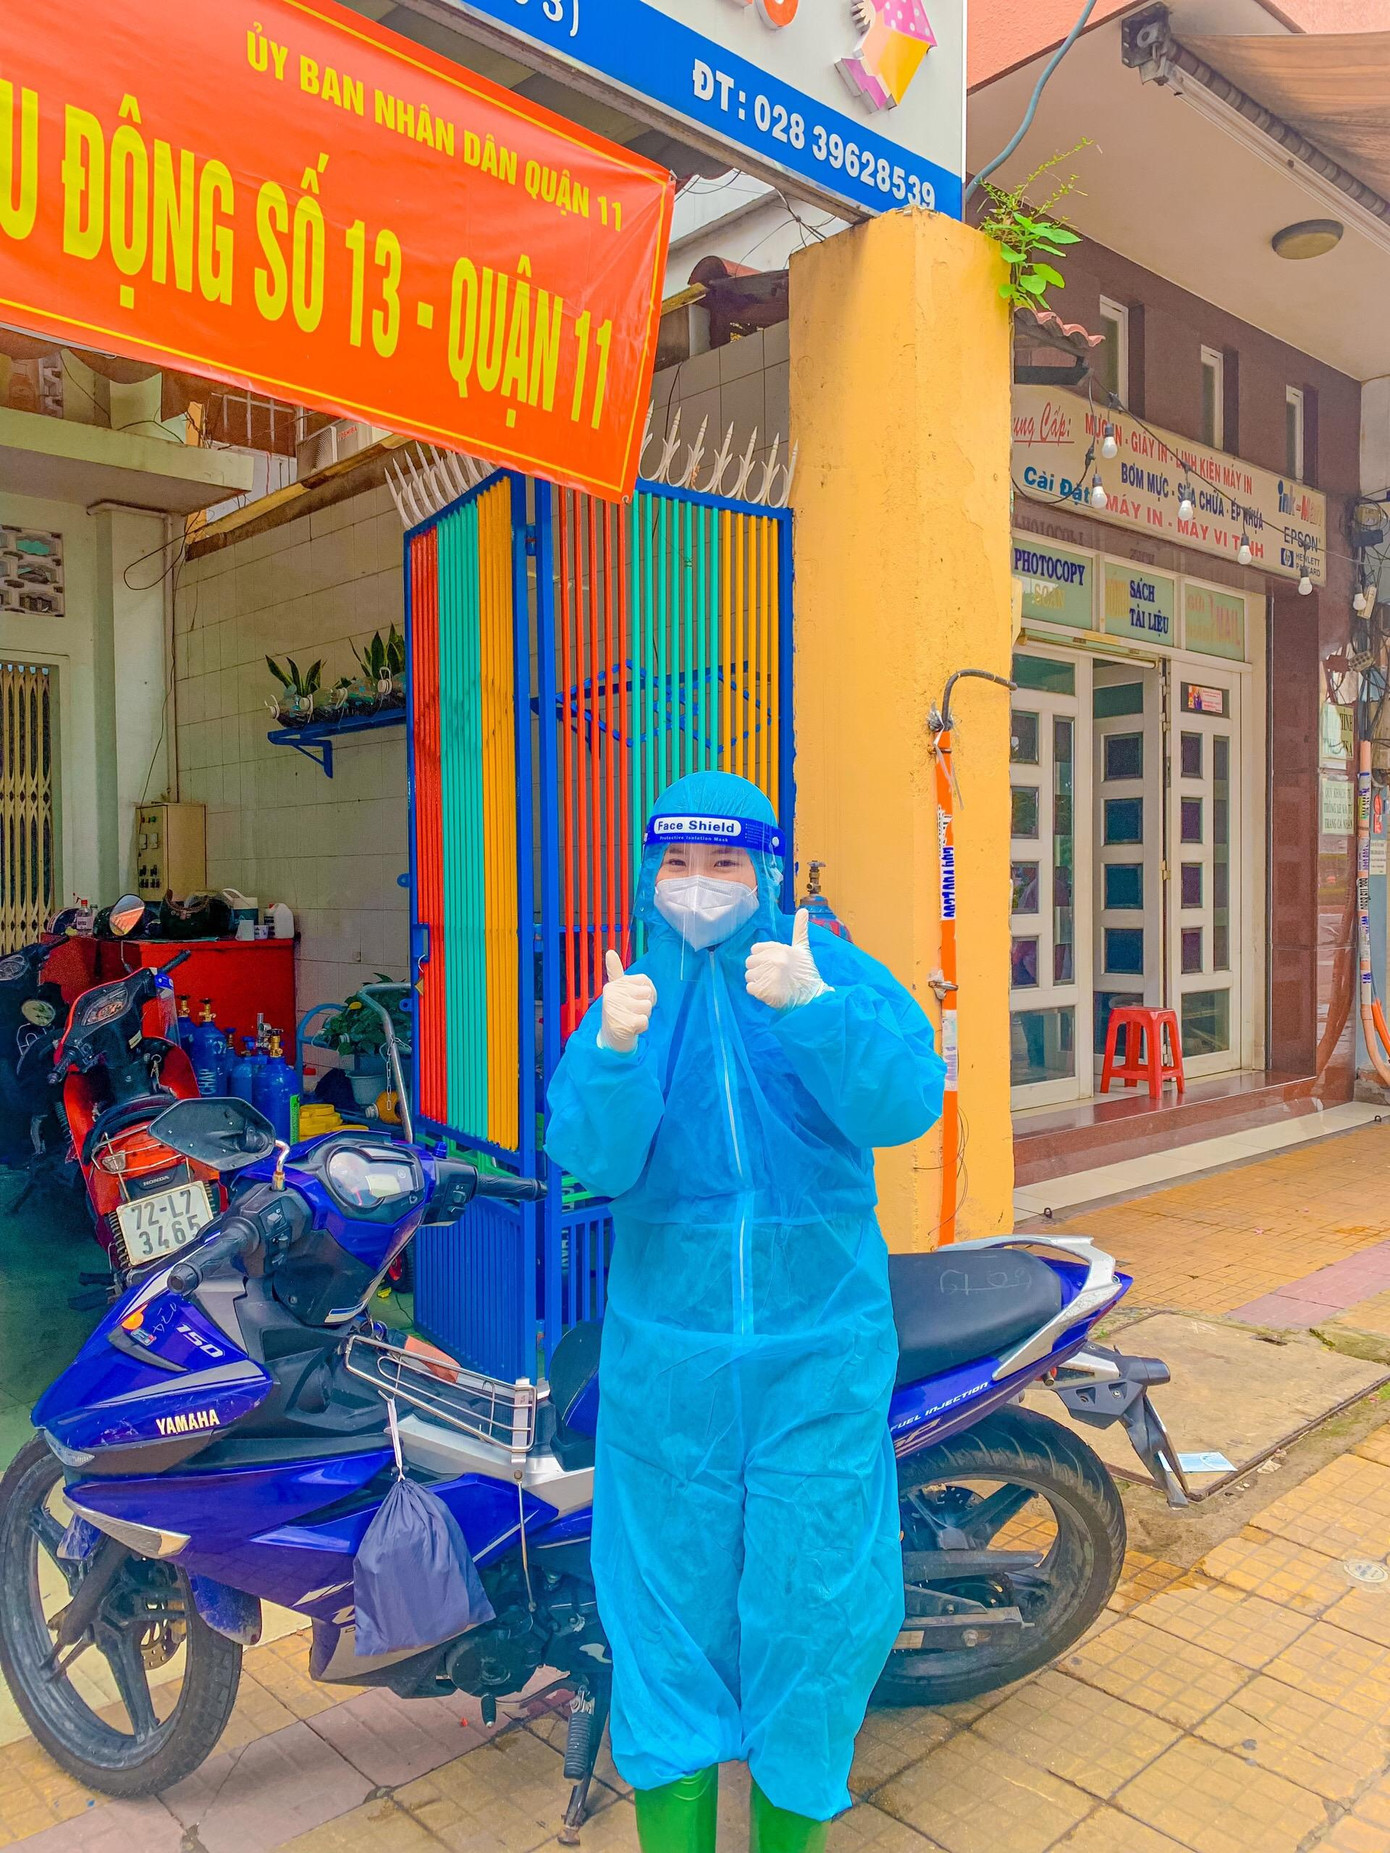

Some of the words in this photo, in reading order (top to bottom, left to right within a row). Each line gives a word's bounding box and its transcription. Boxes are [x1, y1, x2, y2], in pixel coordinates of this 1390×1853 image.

[247, 21, 288, 81] ỦY
[300, 54, 364, 117] BAN
[374, 88, 455, 157] NHÂN
[464, 130, 517, 186] DÂN
[525, 160, 589, 218] QUẬN
[597, 196, 622, 232] 11
[754, 94, 805, 150] 028
[812, 125, 935, 211] 39628539
[61, 93, 235, 310] ĐỘNG
[254, 152, 329, 333] SỐ
[345, 219, 402, 358] 13
[448, 254, 564, 428] QUẬN
[571, 310, 613, 430] 11
[1013, 417, 1035, 448] ung
[1121, 462, 1144, 490] BƠM
[1147, 472, 1169, 502] MỰC
[1223, 463, 1242, 491] MÁY
[1243, 474, 1253, 496] IN
[1023, 466, 1055, 492] Cài
[1105, 493, 1142, 520] MÁY
[1146, 507, 1164, 528] IN
[1177, 517, 1209, 541] MÁY
[1213, 528, 1228, 547] VI
[1231, 533, 1264, 560] TNH
[1013, 547, 1086, 586] PHOTOCOPY
[1129, 577, 1156, 603] SÁCH
[1129, 603, 1146, 629] TÀI
[1148, 609, 1170, 638] LIỆU
[658, 821, 683, 831] Face
[689, 820, 735, 833] Shield
[143, 1175, 170, 1187] HONDA
[131, 1189, 192, 1230] 72-L7
[138, 1214, 200, 1256] 3465
[175, 1323, 225, 1358] 150
[155, 1408, 221, 1436] YAMAHA
[889, 1414, 922, 1433] FUEL
[924, 1381, 989, 1417] INJECTION
